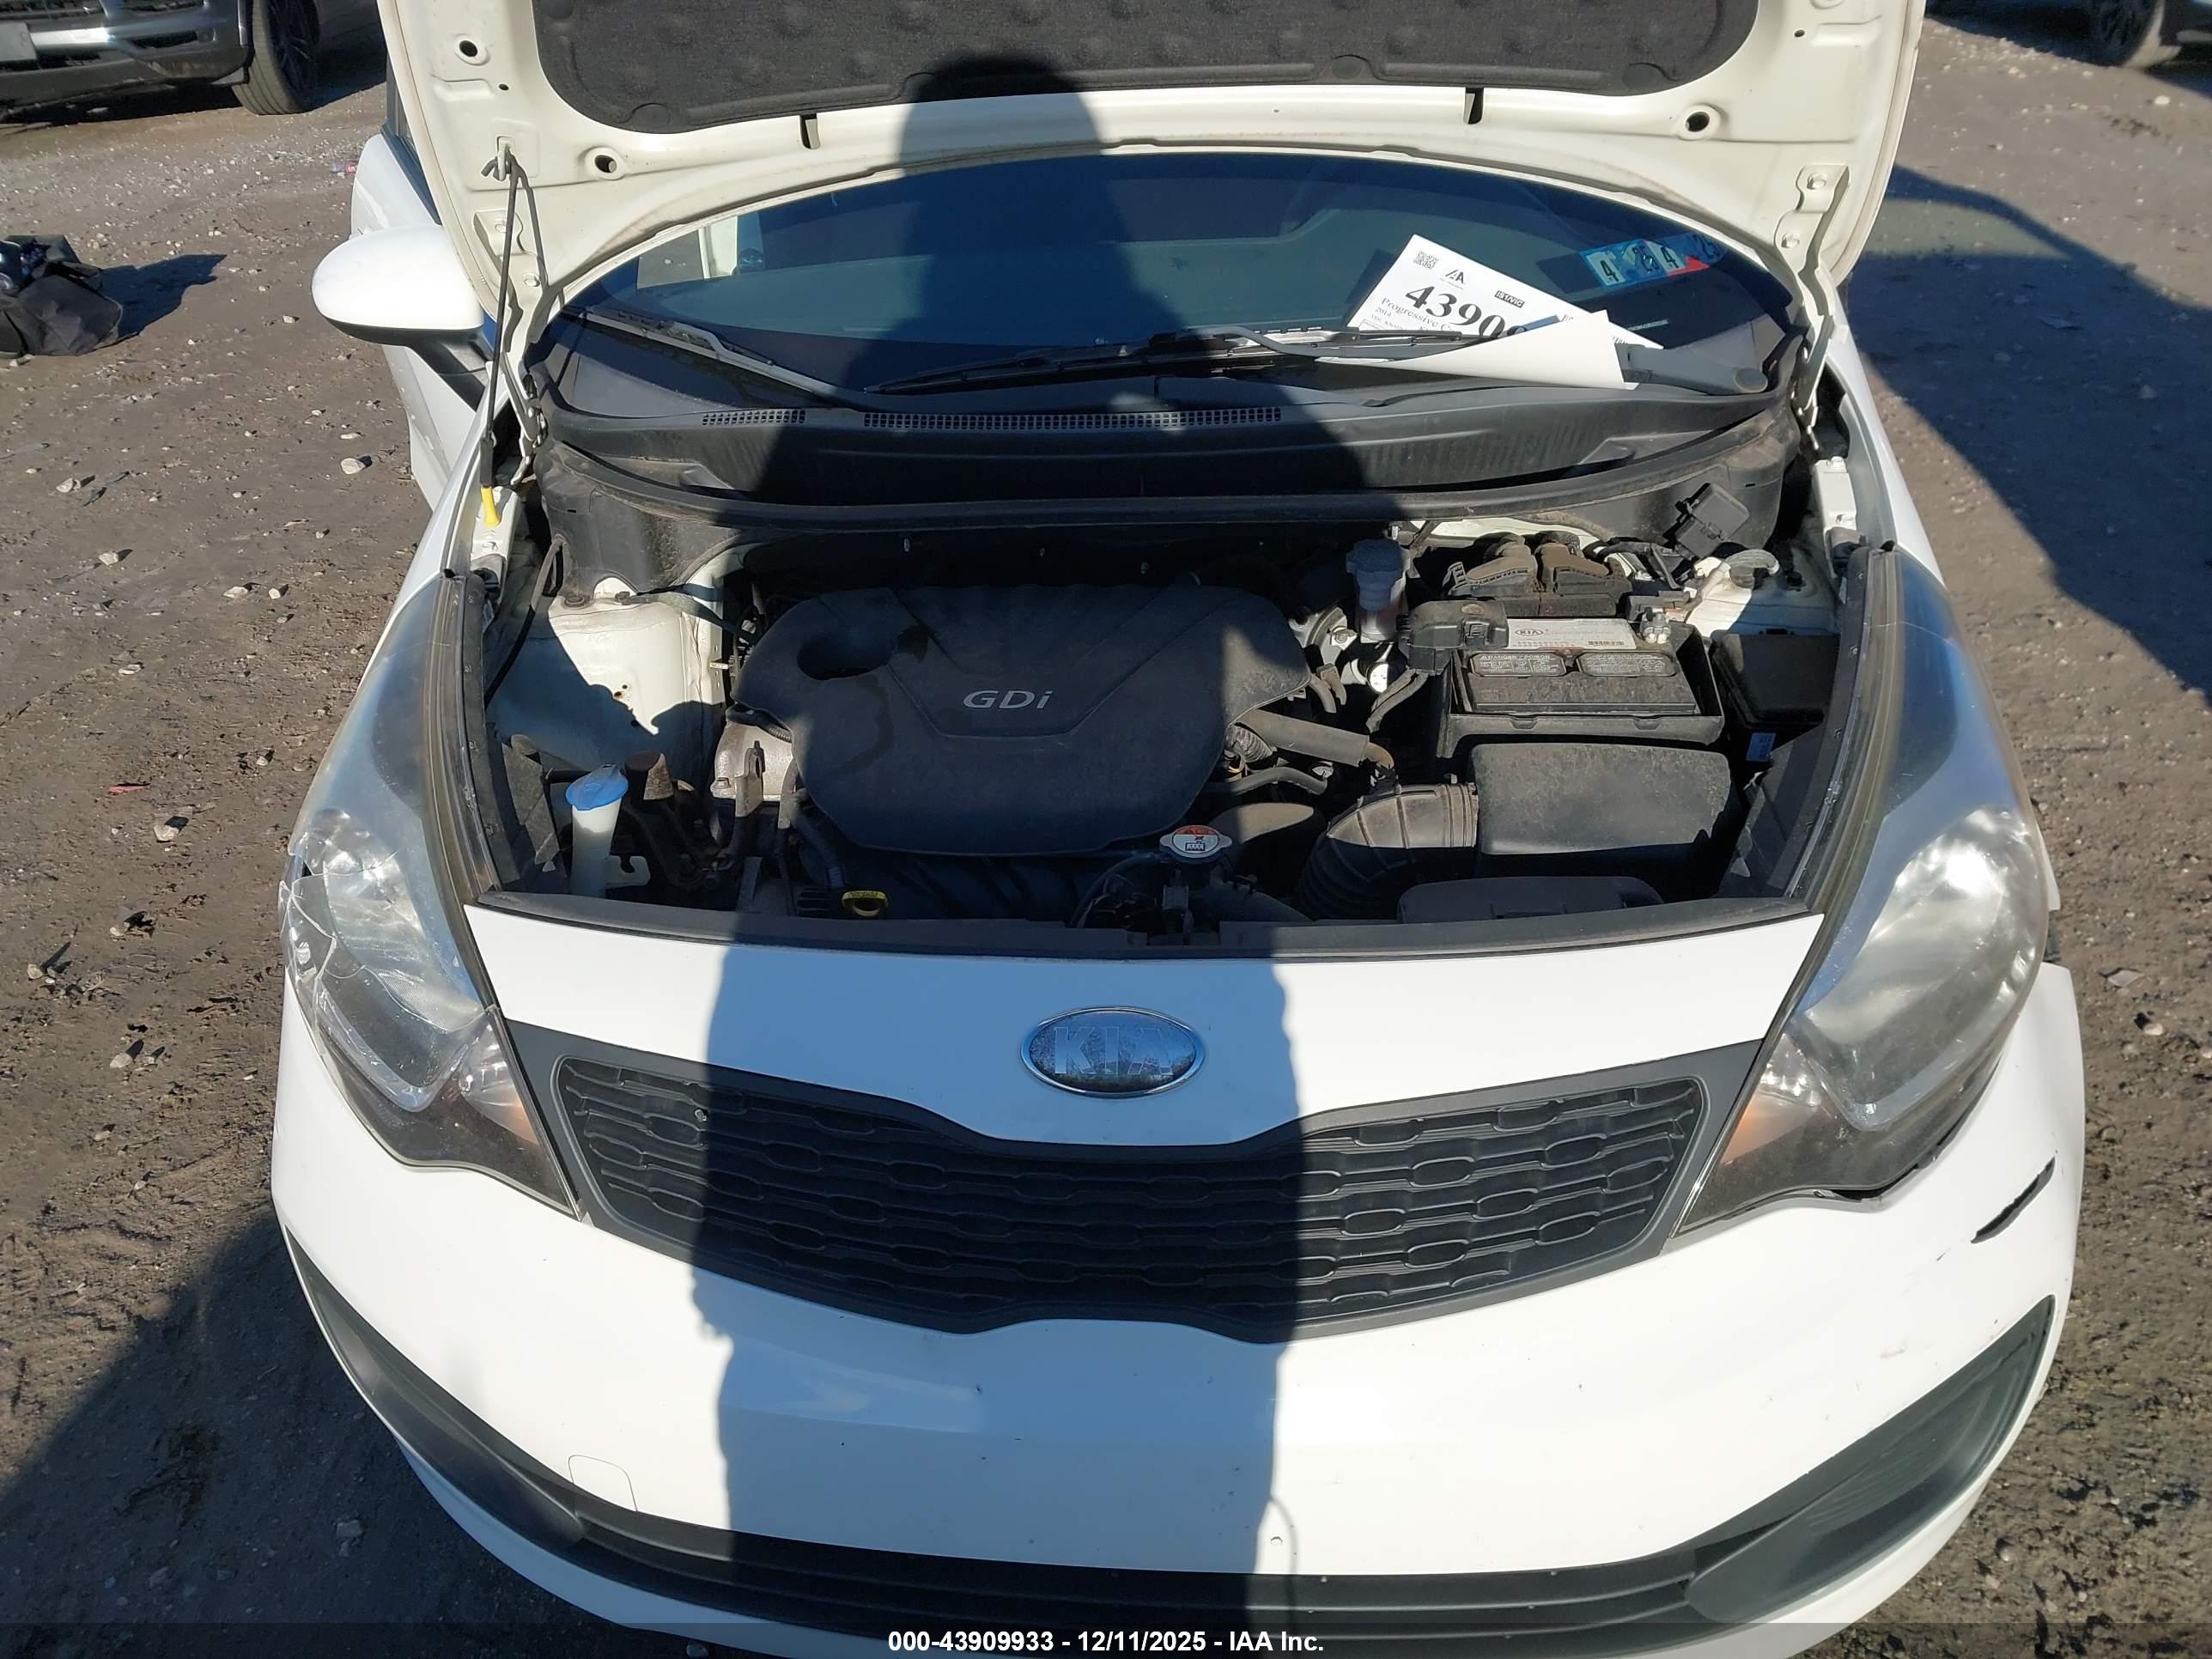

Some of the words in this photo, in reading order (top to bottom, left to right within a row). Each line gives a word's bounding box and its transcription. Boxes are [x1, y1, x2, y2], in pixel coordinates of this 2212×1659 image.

[1660, 246, 1680, 269] 4
[1600, 259, 1620, 283] 4
[1381, 297, 1438, 327] Progressive
[963, 690, 1054, 709] GDi
[1053, 1026, 1174, 1077] KIA
